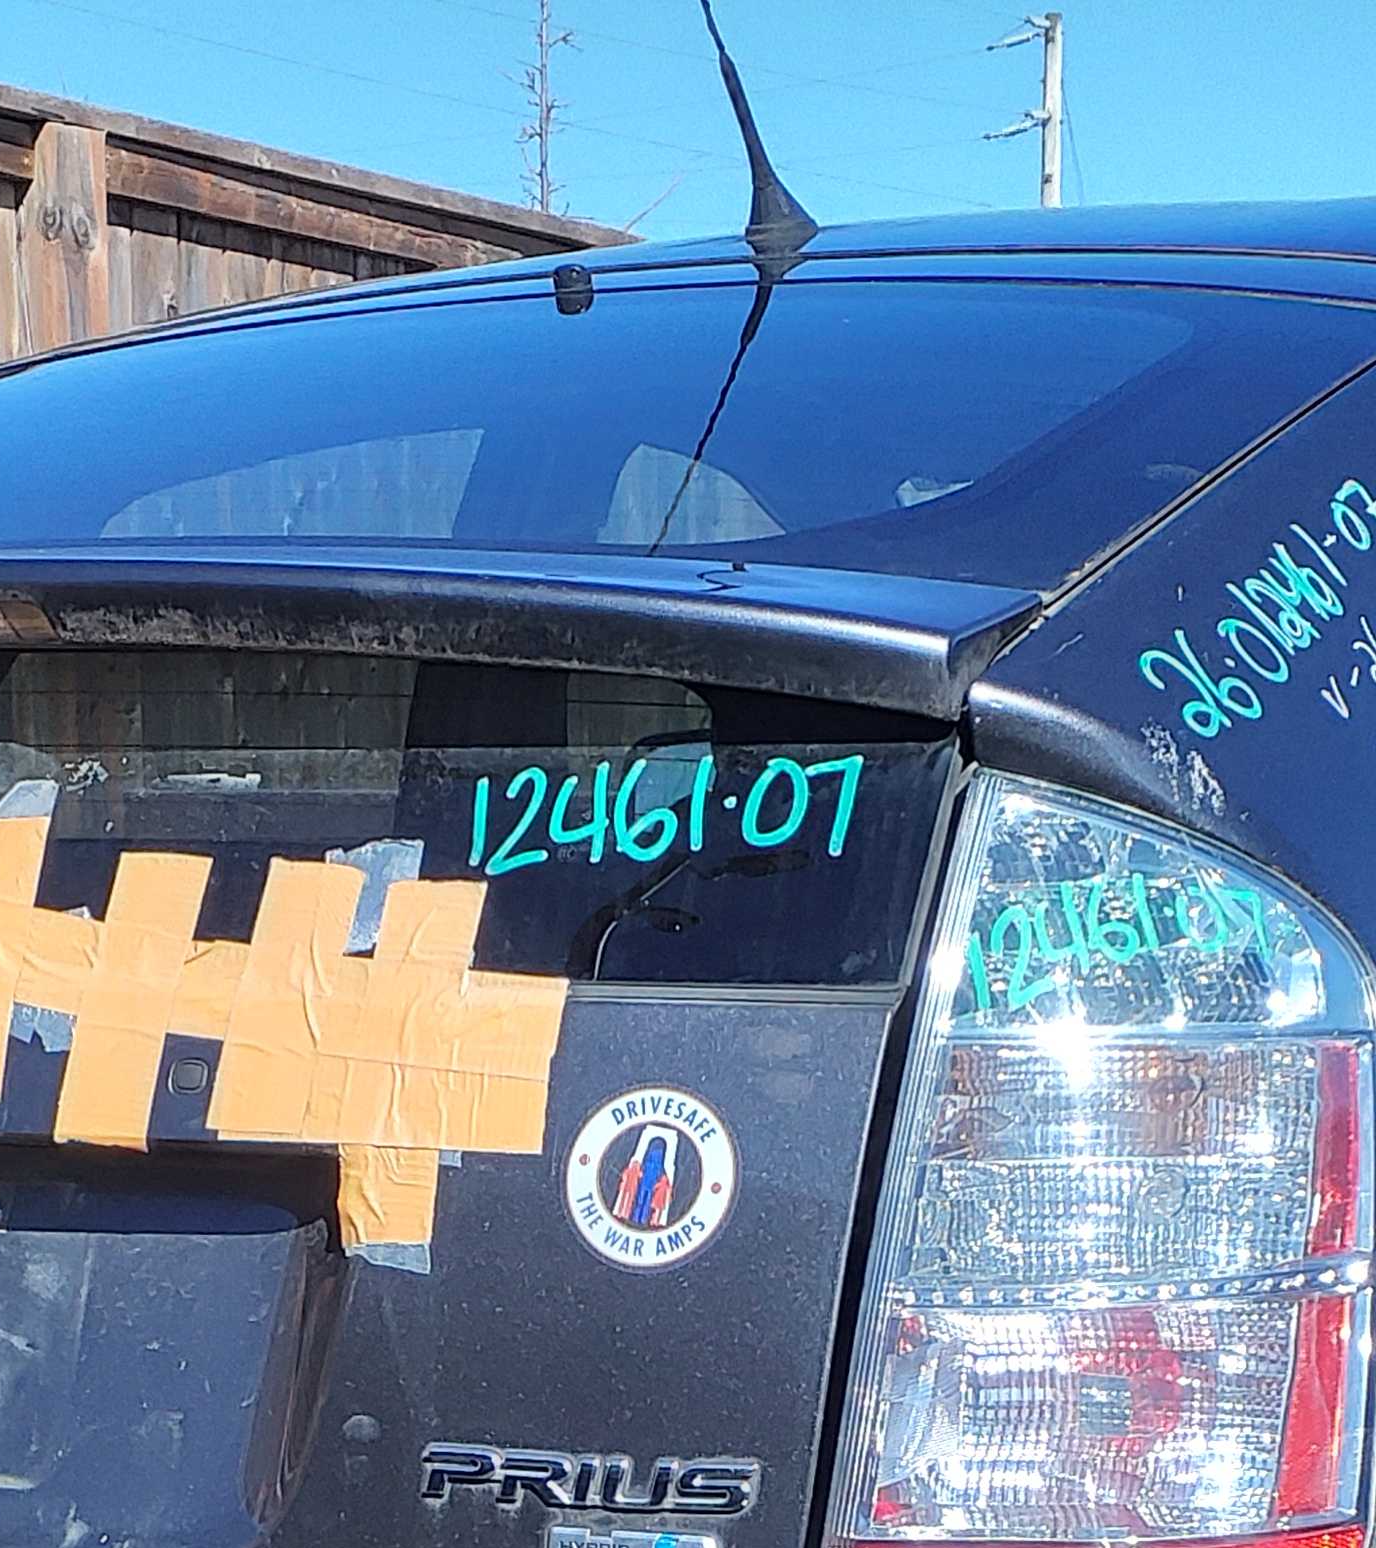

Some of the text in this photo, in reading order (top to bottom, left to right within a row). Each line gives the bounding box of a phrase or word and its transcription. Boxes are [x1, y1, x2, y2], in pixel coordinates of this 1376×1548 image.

[611, 1096, 717, 1143] DRIVESAFE
[576, 1192, 706, 1257] THE WAR AMPS
[421, 1442, 760, 1515] PRIUS
